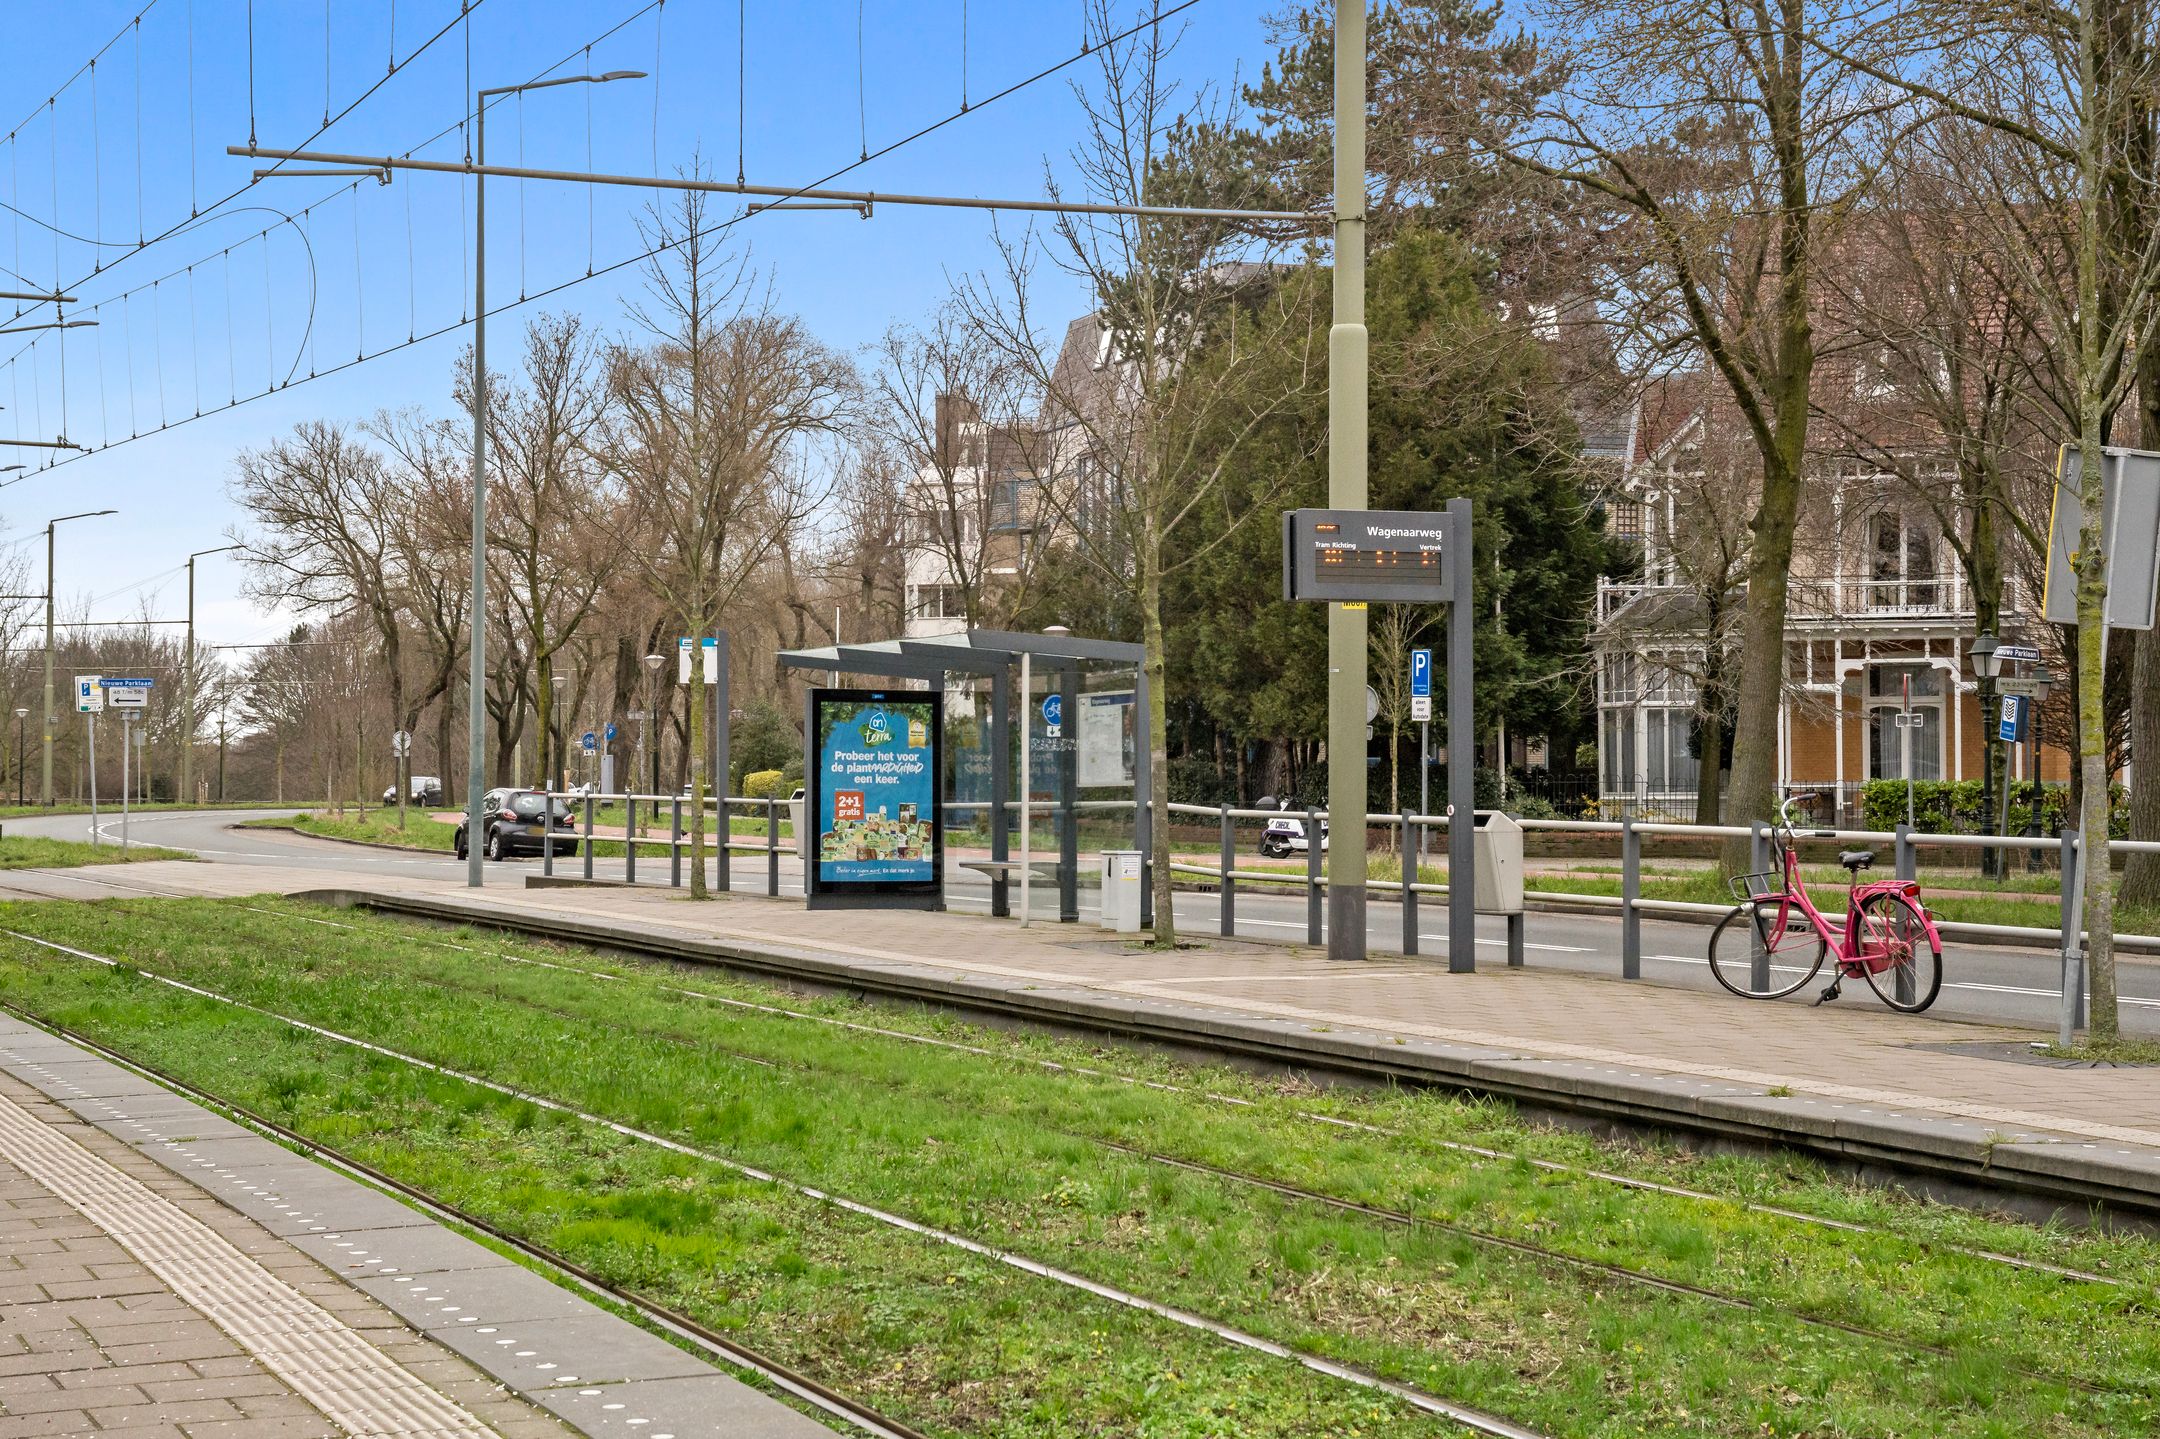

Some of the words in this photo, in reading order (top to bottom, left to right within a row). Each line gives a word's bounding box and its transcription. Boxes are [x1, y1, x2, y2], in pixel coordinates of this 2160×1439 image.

[1367, 526, 1442, 540] Wagenaarweg
[1332, 542, 1356, 550] Richting
[864, 729, 892, 743] terra
[834, 751, 875, 761] Probeer
[877, 751, 894, 761] het
[896, 753, 920, 761] voor
[831, 762, 844, 772] de
[853, 775, 873, 784] een
[875, 774, 900, 784] keer.
[838, 796, 861, 807] 2+1
[838, 808, 861, 816] gratis
